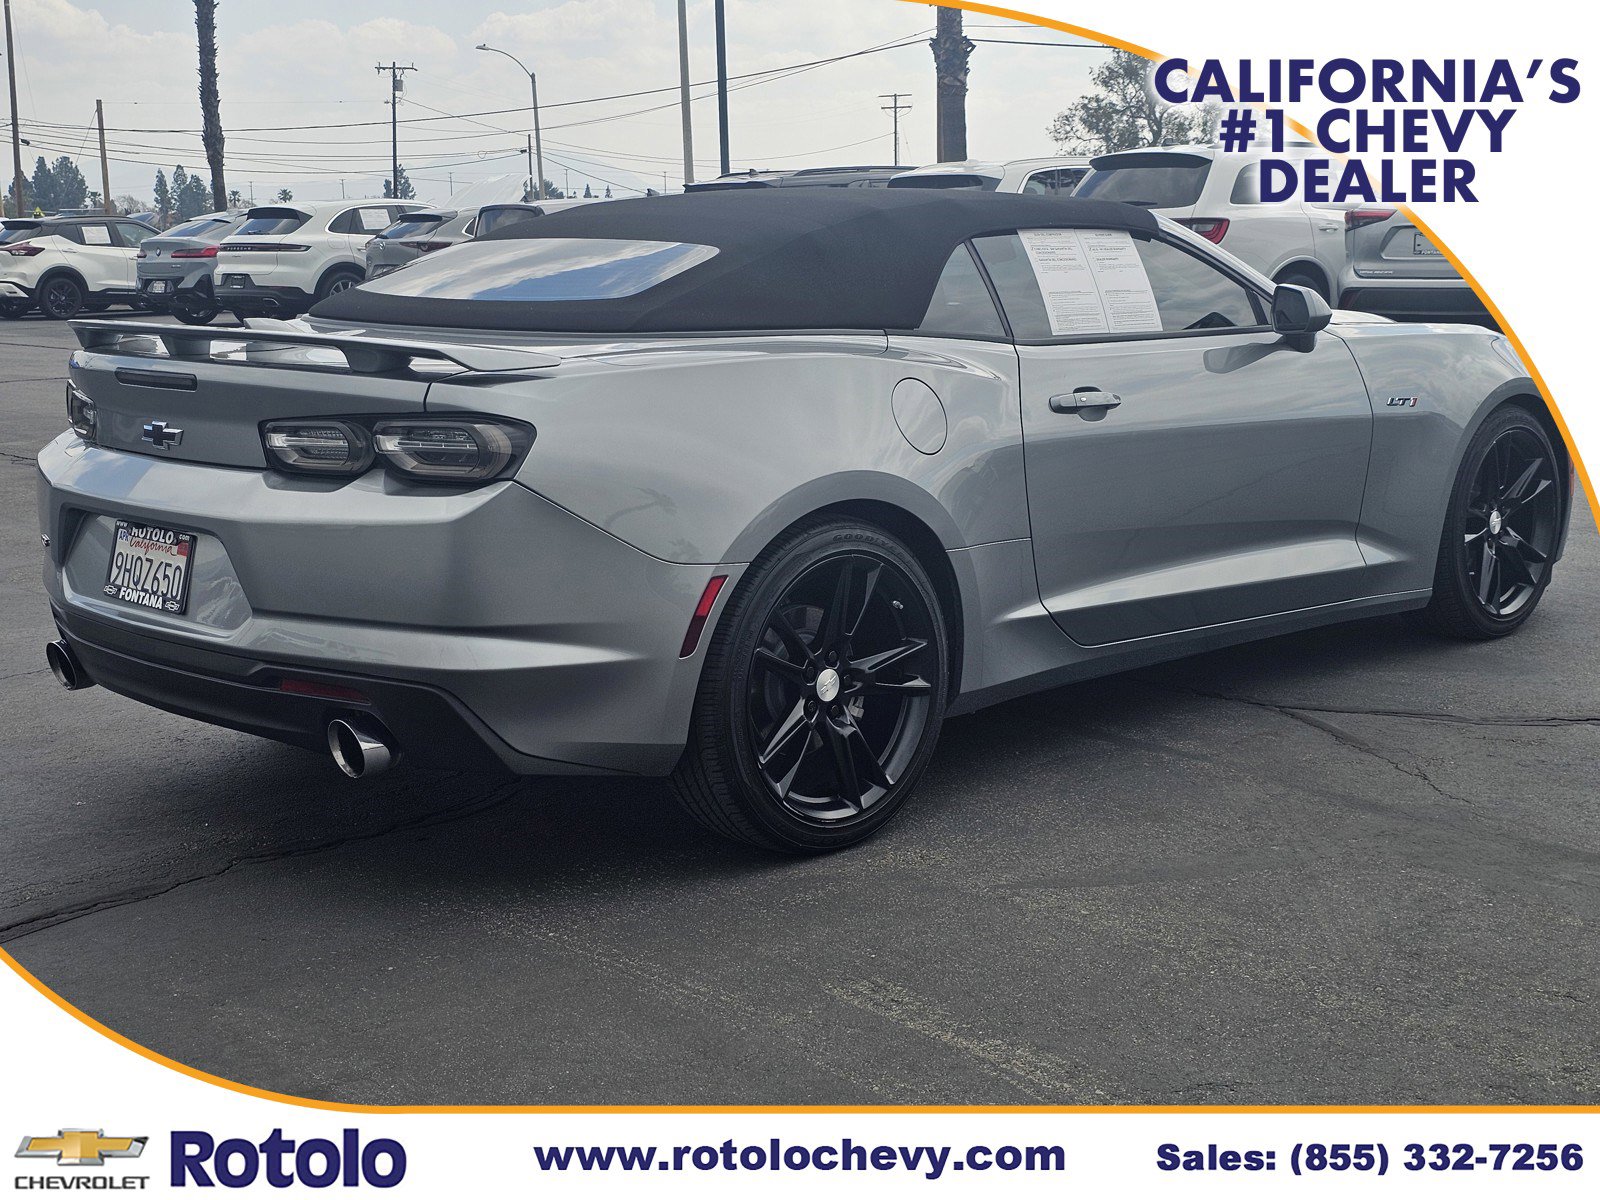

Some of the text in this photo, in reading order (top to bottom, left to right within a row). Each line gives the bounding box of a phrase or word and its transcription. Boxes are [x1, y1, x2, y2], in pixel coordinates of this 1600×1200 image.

[129, 536, 178, 556] California
[110, 551, 183, 600] 9HQZ650
[119, 586, 163, 610] FONTANA
